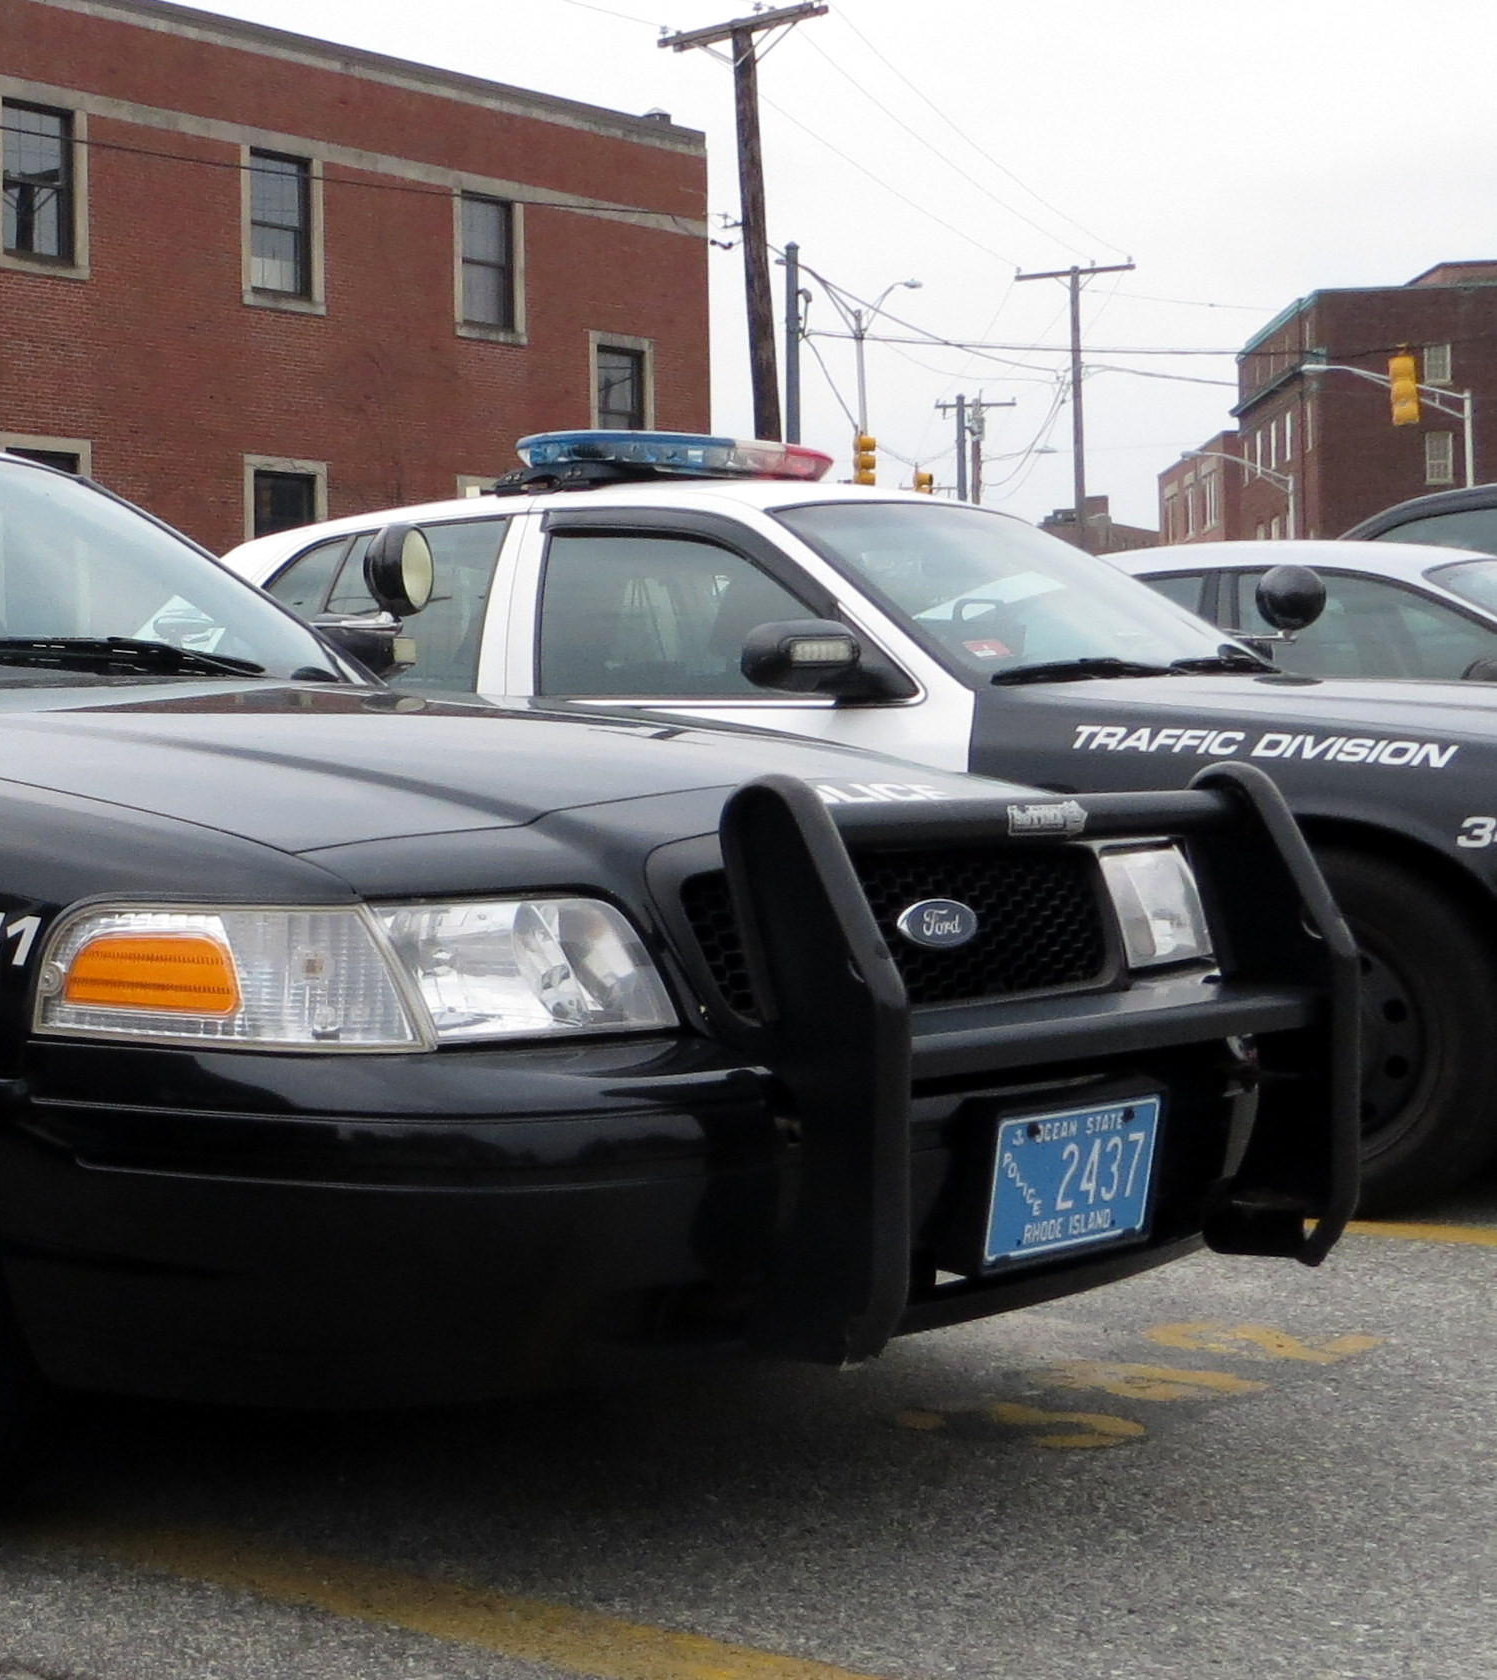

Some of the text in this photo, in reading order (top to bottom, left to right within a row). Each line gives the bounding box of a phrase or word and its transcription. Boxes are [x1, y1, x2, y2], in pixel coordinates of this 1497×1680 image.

[1072, 725, 1459, 768] TRAFFIC DIVISION
[1456, 816, 1497, 848] 3
[922, 908, 962, 936] Ford
[1035, 1112, 1124, 1143] OCEAN STATE
[1002, 1152, 1042, 1216] POLICE
[1055, 1131, 1145, 1211] 2437
[1023, 1208, 1111, 1245] RHODE ISLAND
